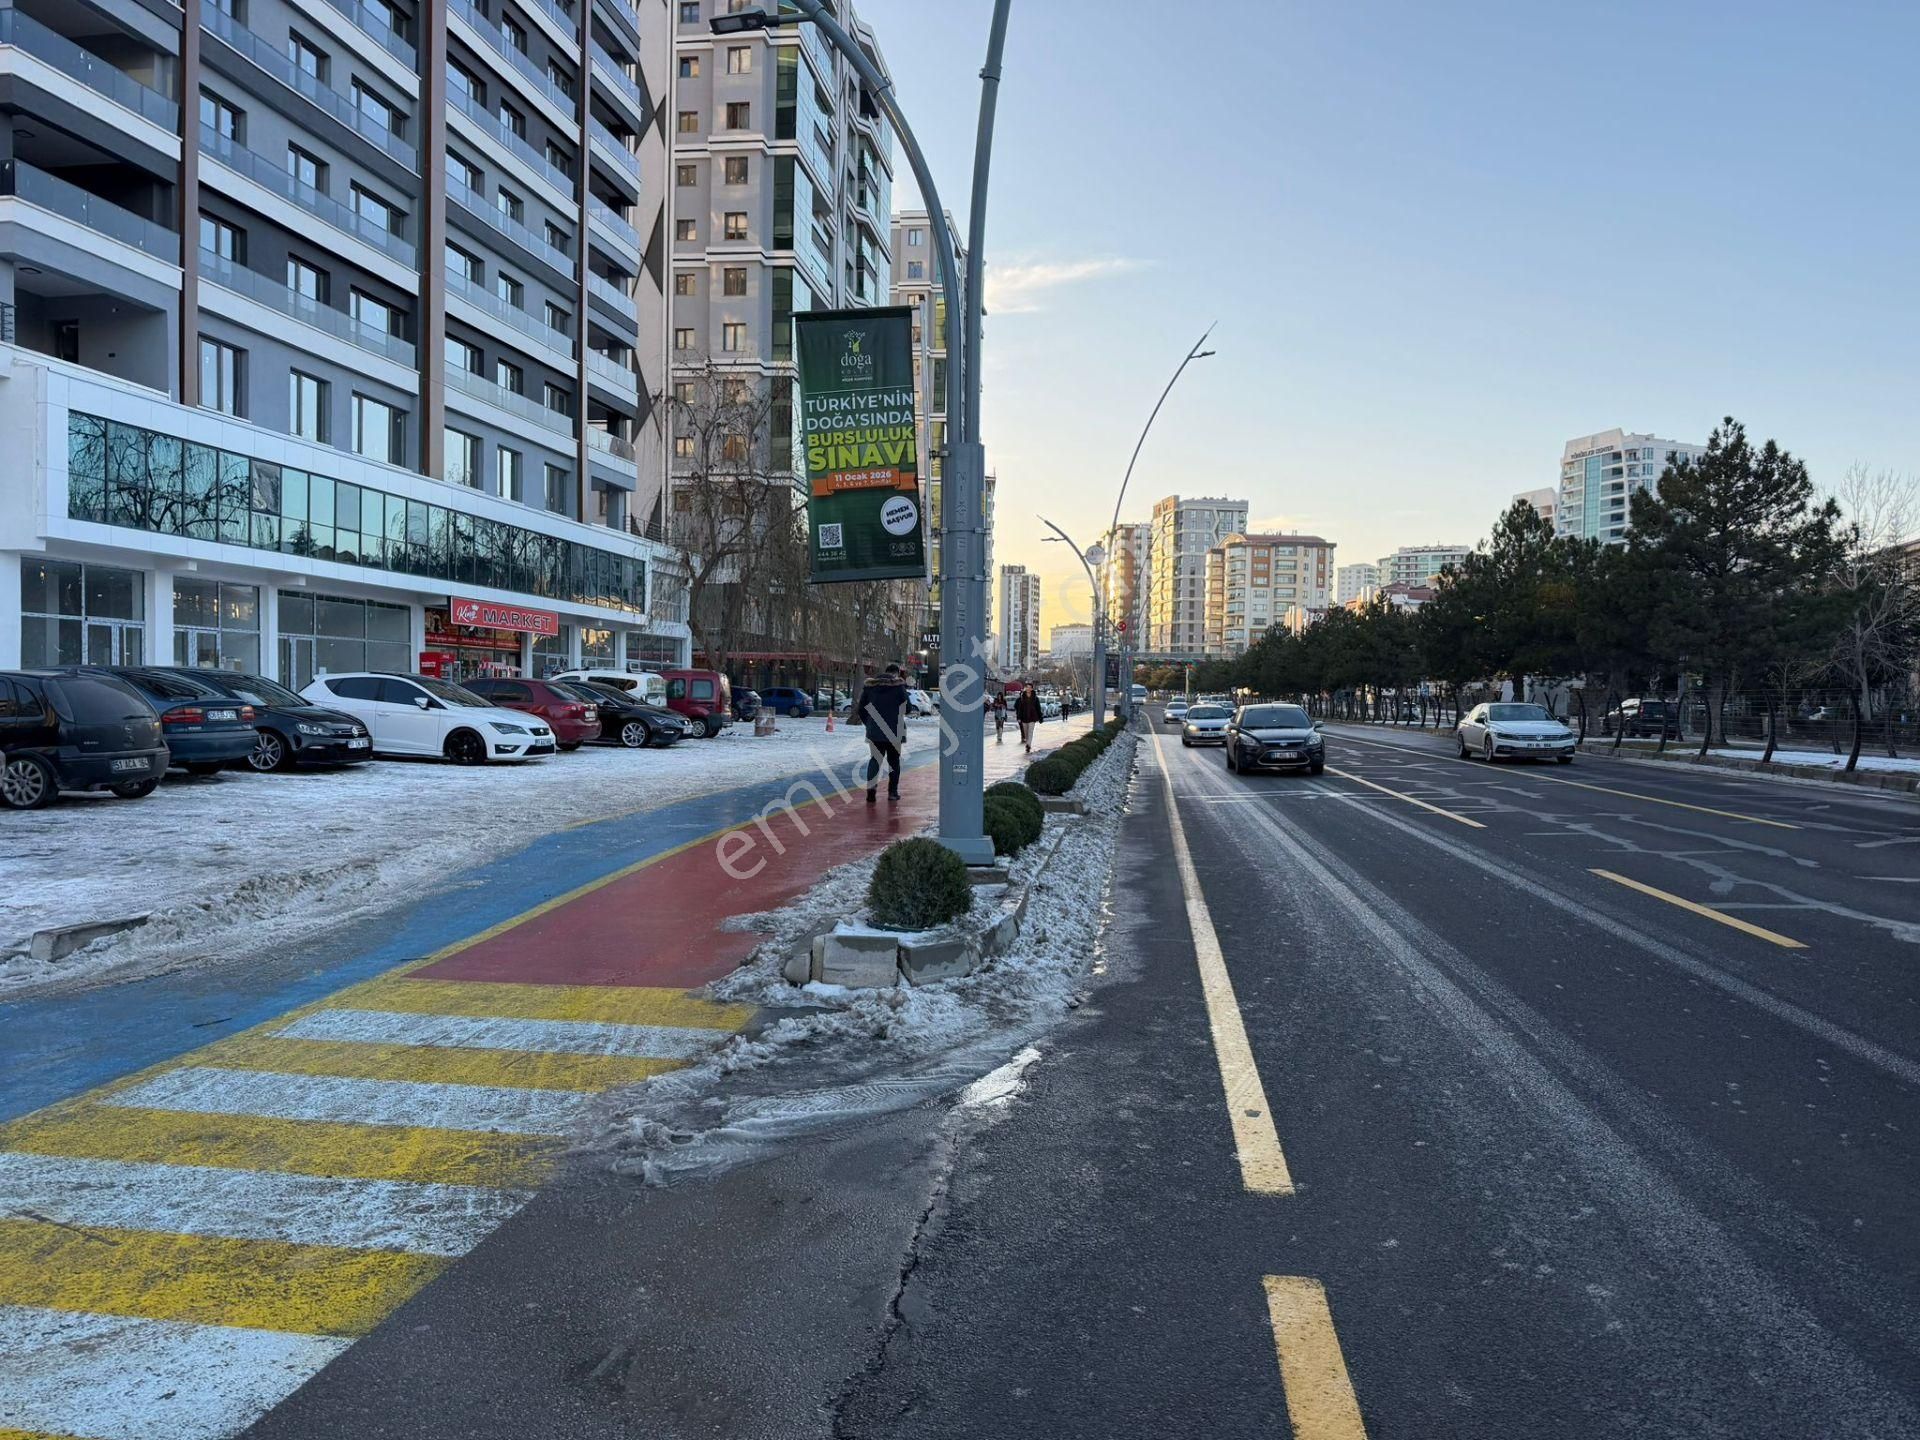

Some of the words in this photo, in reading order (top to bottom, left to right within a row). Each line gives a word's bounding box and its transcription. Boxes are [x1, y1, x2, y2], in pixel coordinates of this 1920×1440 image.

[805, 389, 914, 413] TÜRKİYE'NİN
[806, 410, 914, 431] DOĞA'SINDA
[807, 426, 914, 447] BURSLULUK
[808, 440, 916, 471] SINAVI
[834, 474, 842, 482] 11
[844, 472, 868, 481] Ocak
[870, 470, 892, 479] 2026
[886, 504, 910, 517] HEMEN
[886, 512, 914, 525] BAŞVUR
[483, 607, 551, 631] MARKET
